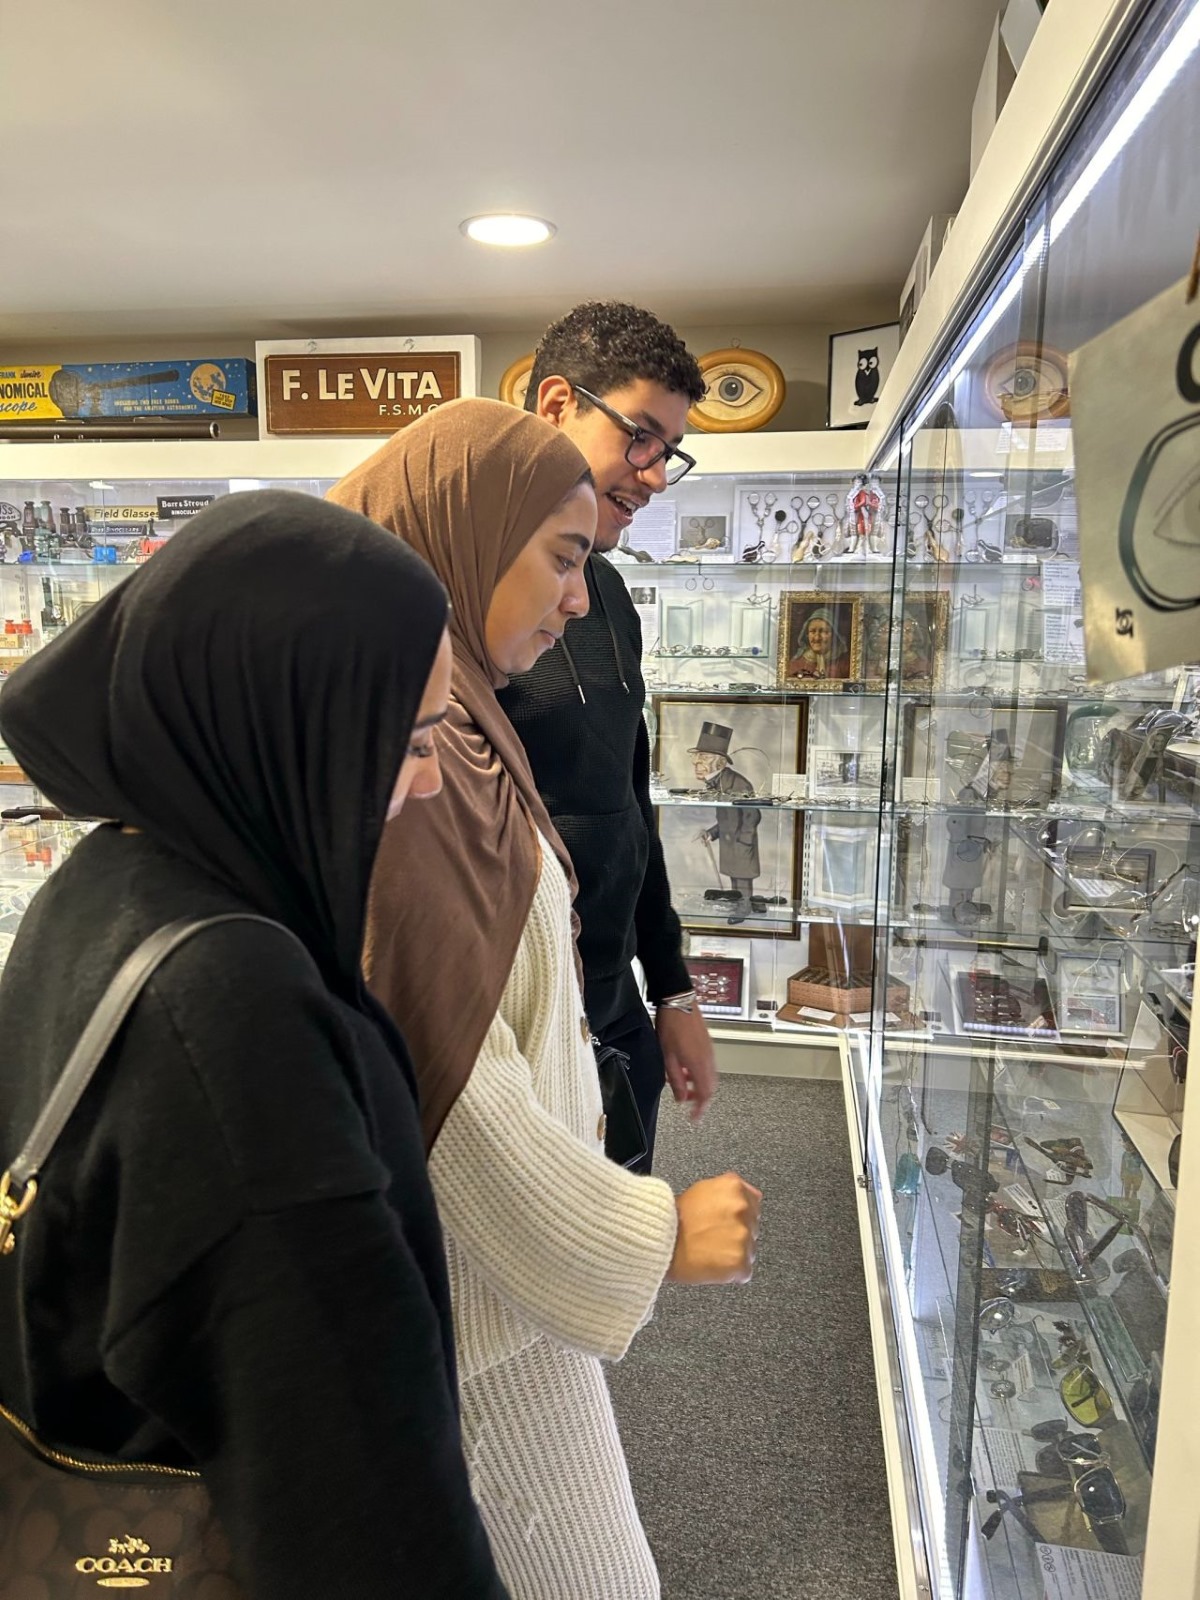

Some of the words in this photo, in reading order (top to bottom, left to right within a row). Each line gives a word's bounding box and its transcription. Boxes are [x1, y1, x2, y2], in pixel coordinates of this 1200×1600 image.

[282, 369, 309, 401] F.
[94, 508, 119, 518] Field
[122, 508, 159, 518] Glasses
[75, 1557, 173, 1573] COACH
